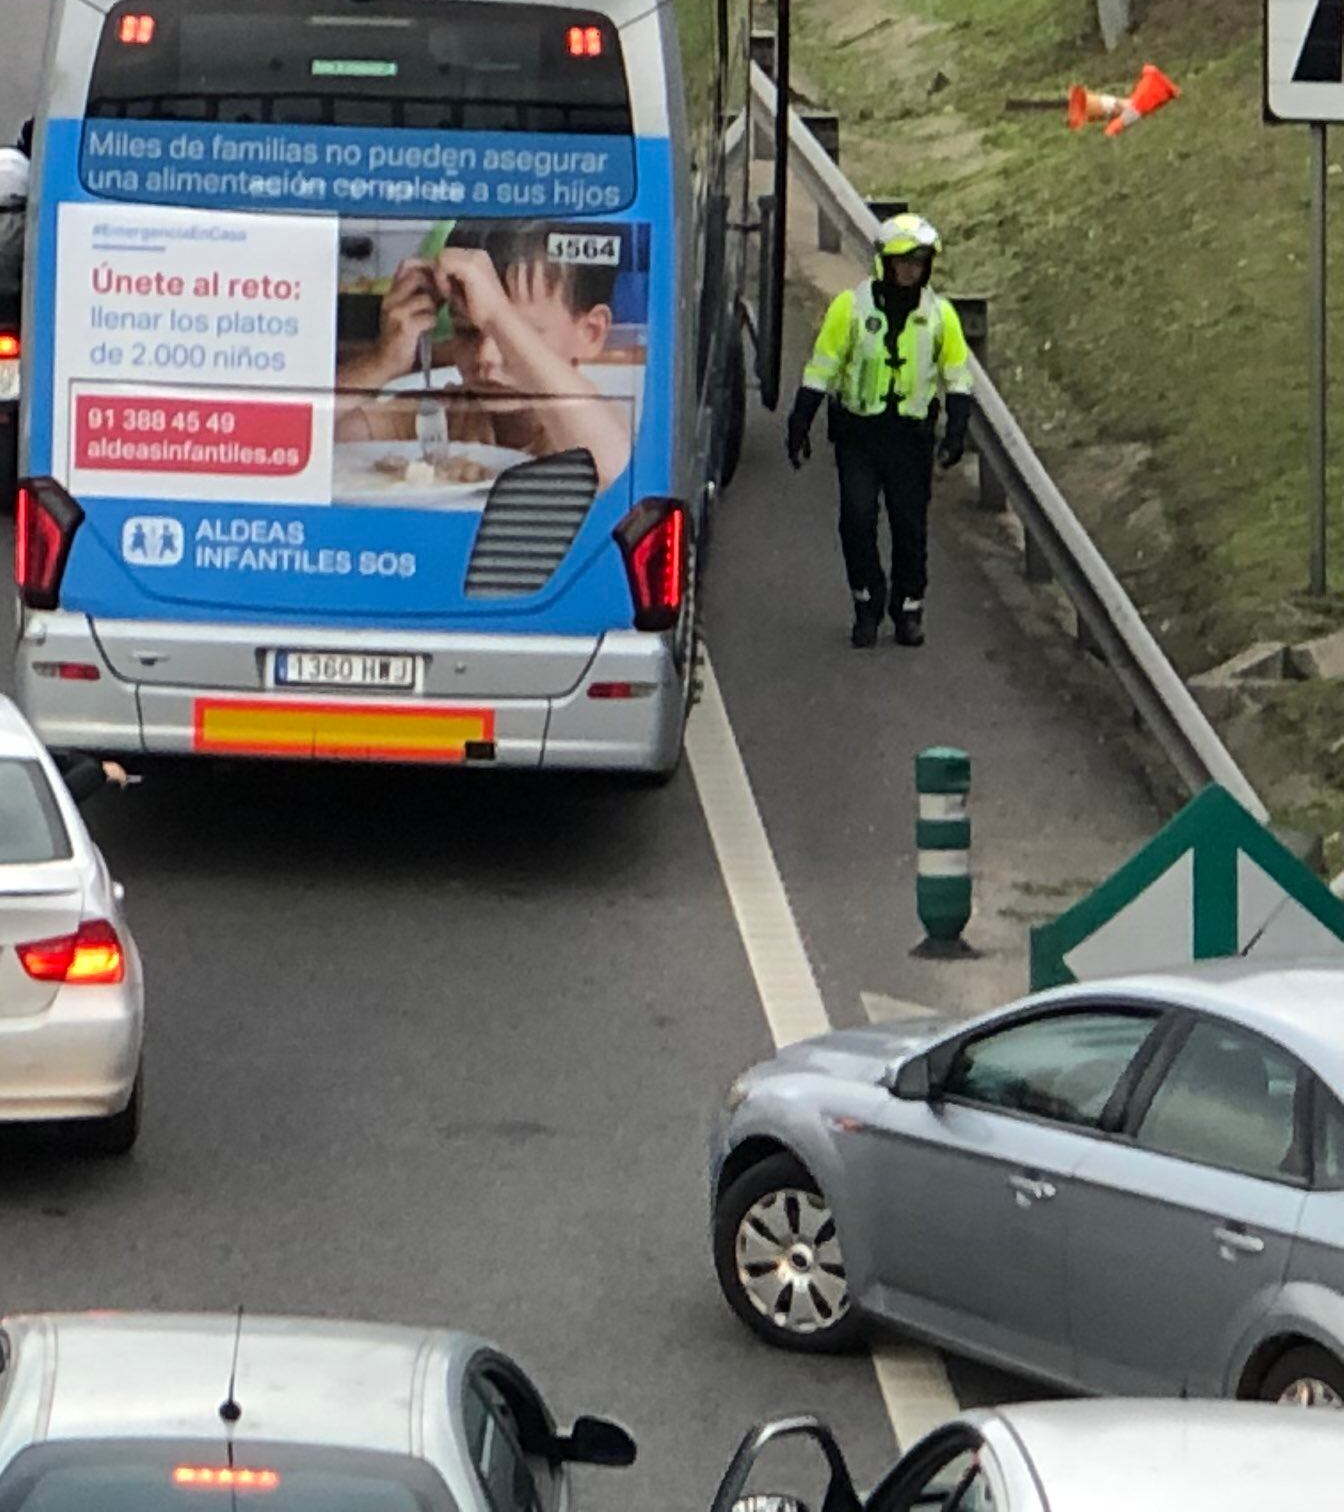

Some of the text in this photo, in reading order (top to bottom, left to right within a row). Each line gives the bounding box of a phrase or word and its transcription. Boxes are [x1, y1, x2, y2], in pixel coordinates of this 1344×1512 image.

[88, 130, 609, 180] Miles de familias no pueden asegurar
[88, 169, 138, 191] una
[145, 166, 326, 199] alimentación
[471, 186, 490, 204] a
[497, 185, 547, 206] sus
[554, 178, 620, 210] hijos
[92, 262, 302, 301] Únete al reto:
[90, 306, 300, 337] llenar los platos
[90, 342, 287, 371] de 2.000 niños
[87, 407, 236, 434] 91 388 45 49
[87, 437, 300, 466] aldeasinfantiles.es
[195, 520, 305, 546] ALDEAS
[195, 543, 417, 578] INFANTILES SOS
[294, 654, 353, 681] 1360
